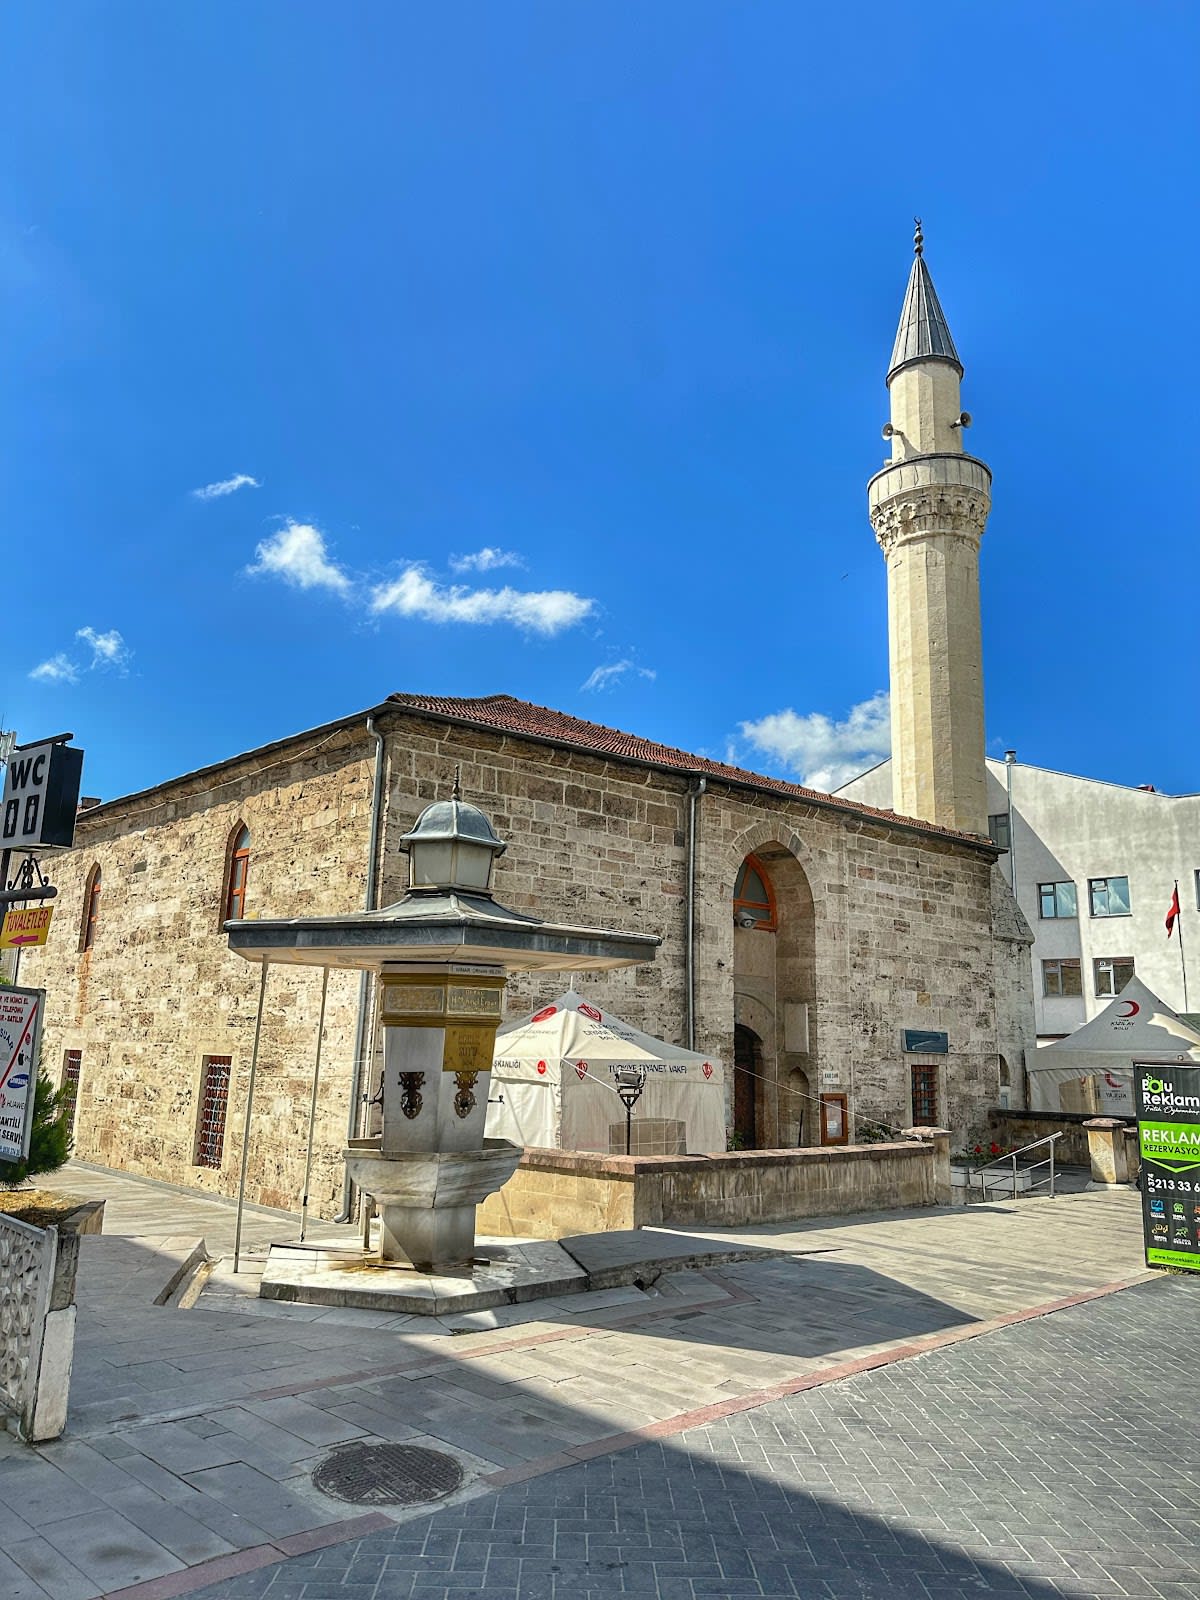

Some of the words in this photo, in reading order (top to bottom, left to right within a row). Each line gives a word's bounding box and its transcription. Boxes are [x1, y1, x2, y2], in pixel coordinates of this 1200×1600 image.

[10, 754, 46, 791] WC
[6, 908, 49, 934] TUVALETLER
[1142, 1079, 1172, 1093] Bolu
[1142, 1091, 1200, 1107] Reklam
[1155, 1178, 1175, 1190] 213
[1177, 1180, 1192, 1192] 33
